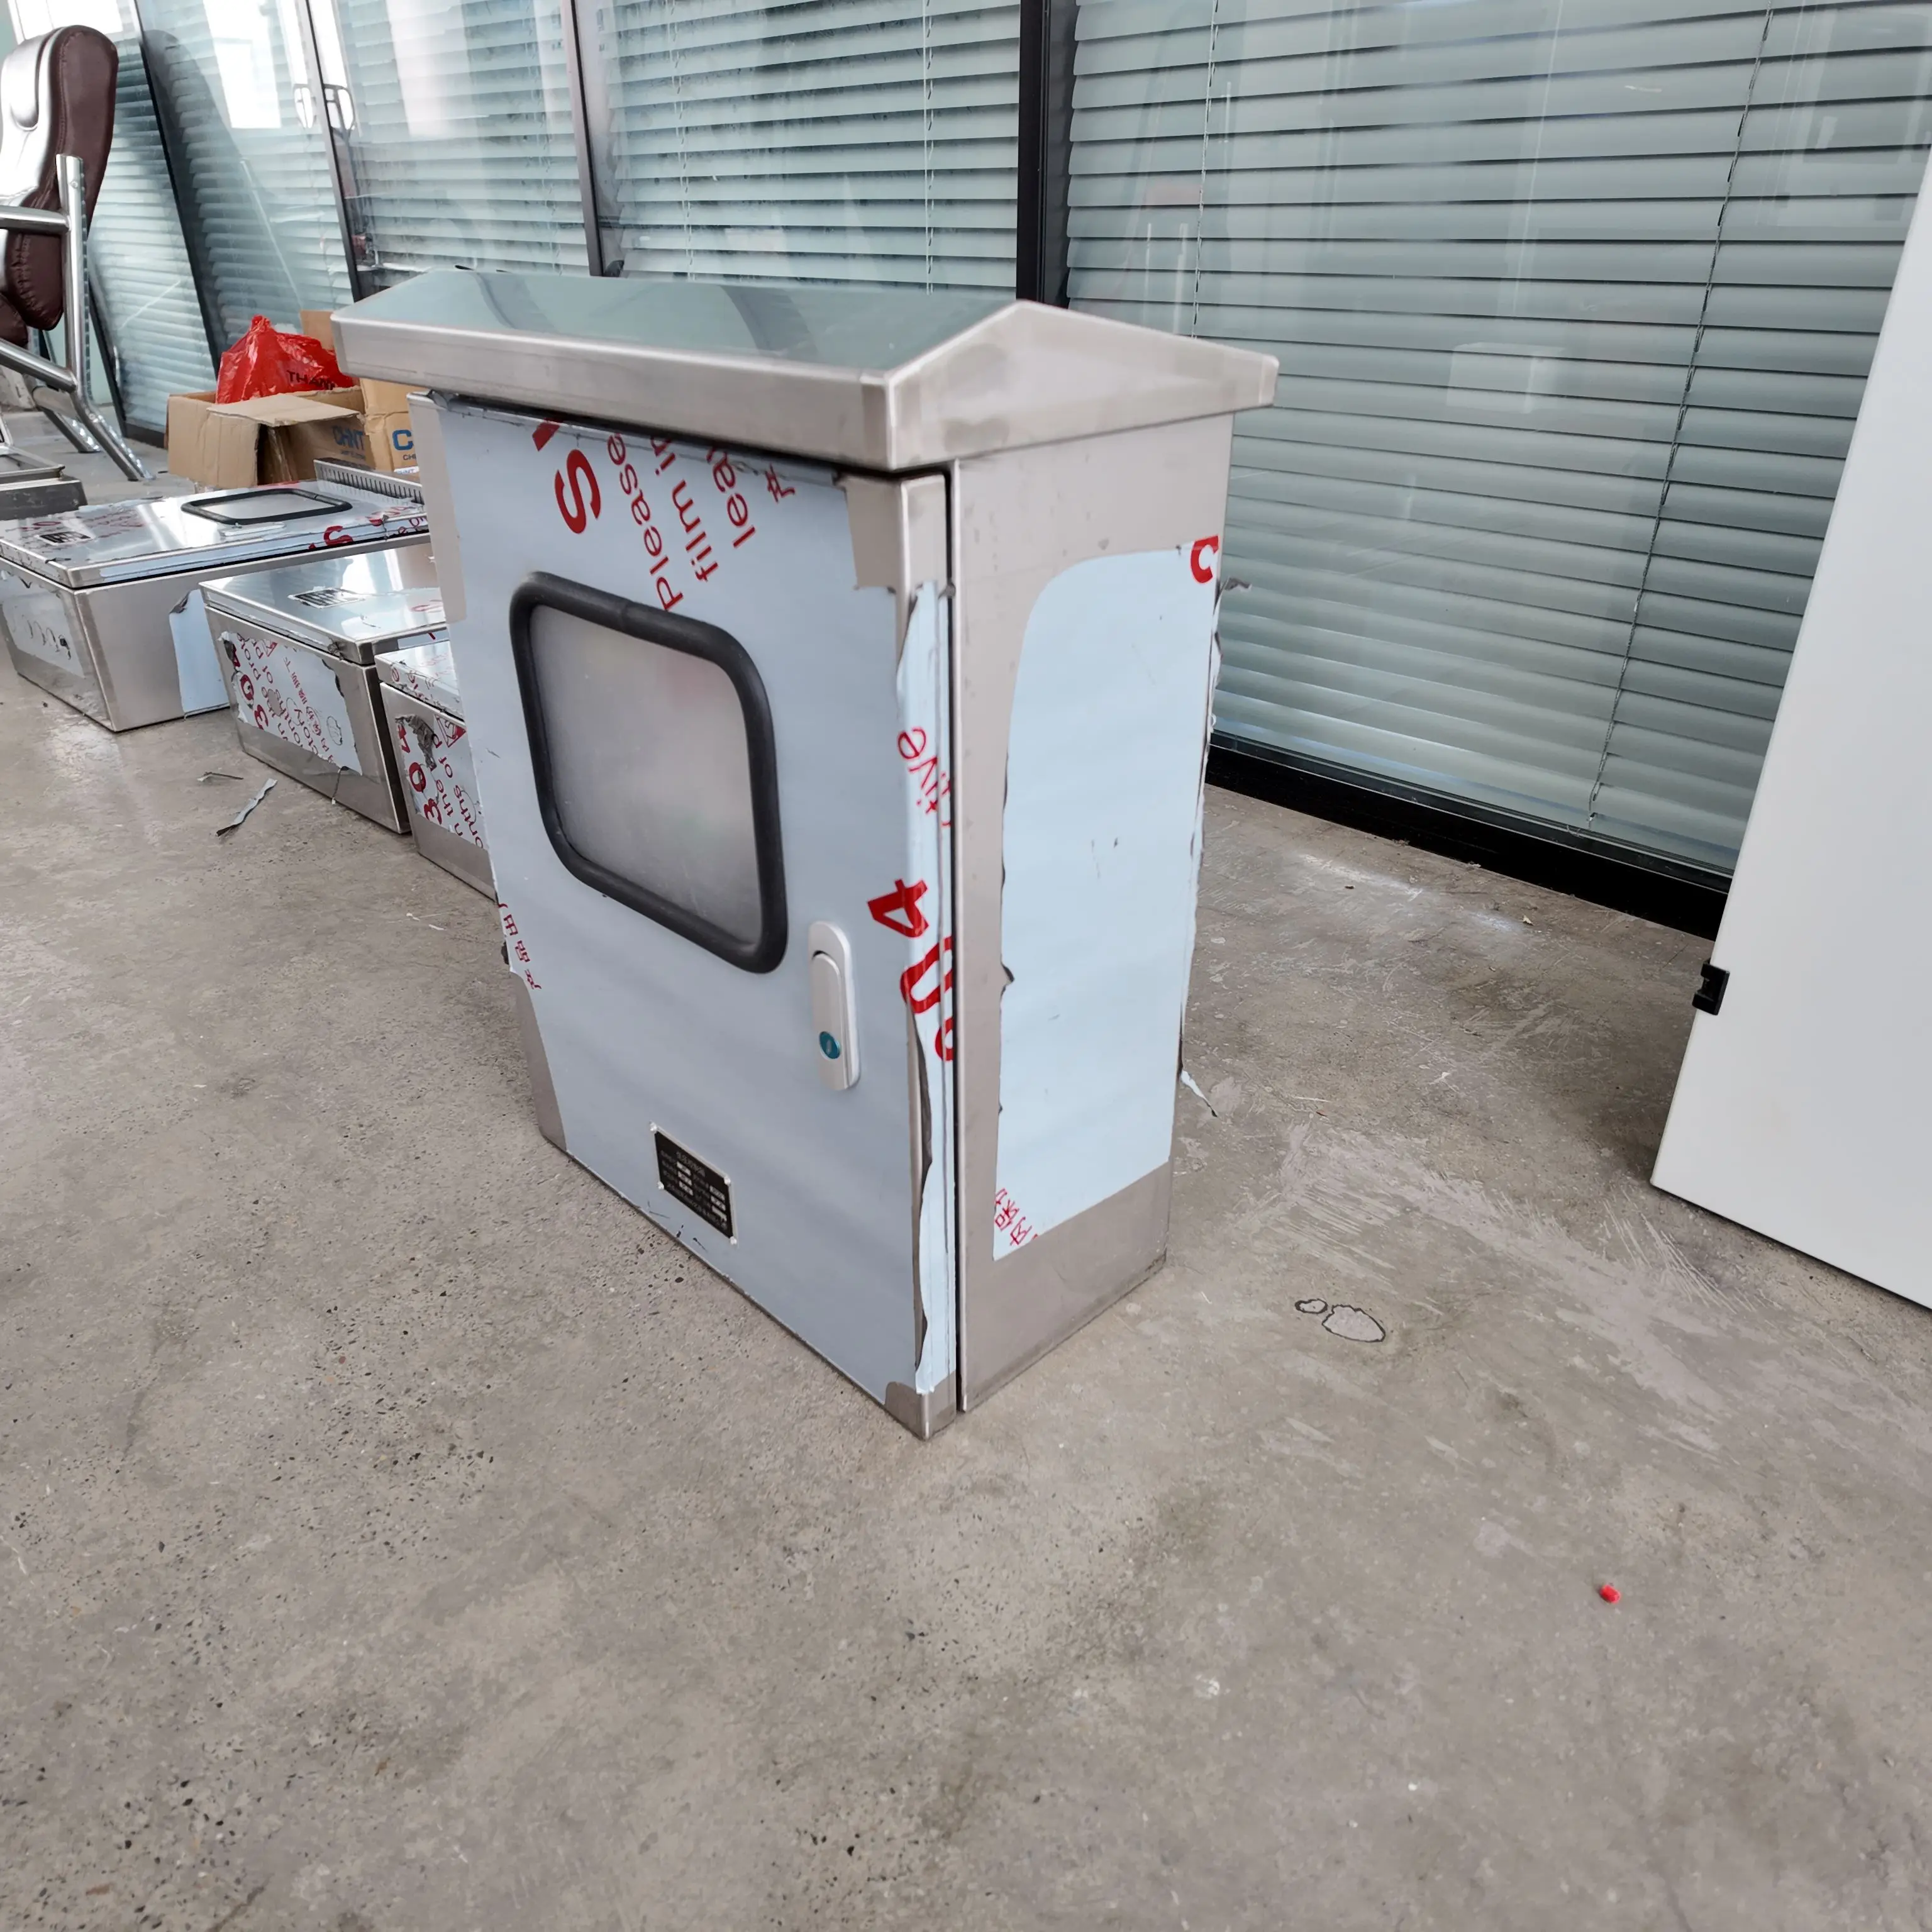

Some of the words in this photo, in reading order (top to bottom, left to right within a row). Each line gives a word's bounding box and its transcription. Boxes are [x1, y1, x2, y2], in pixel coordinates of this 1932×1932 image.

[607, 432, 683, 611] Please
[671, 479, 718, 582] film
[706, 444, 756, 549] lea
[275, 689, 303, 747] onths
[438, 757, 453, 779] of
[435, 779, 453, 817] the
[897, 726, 952, 828] tive
